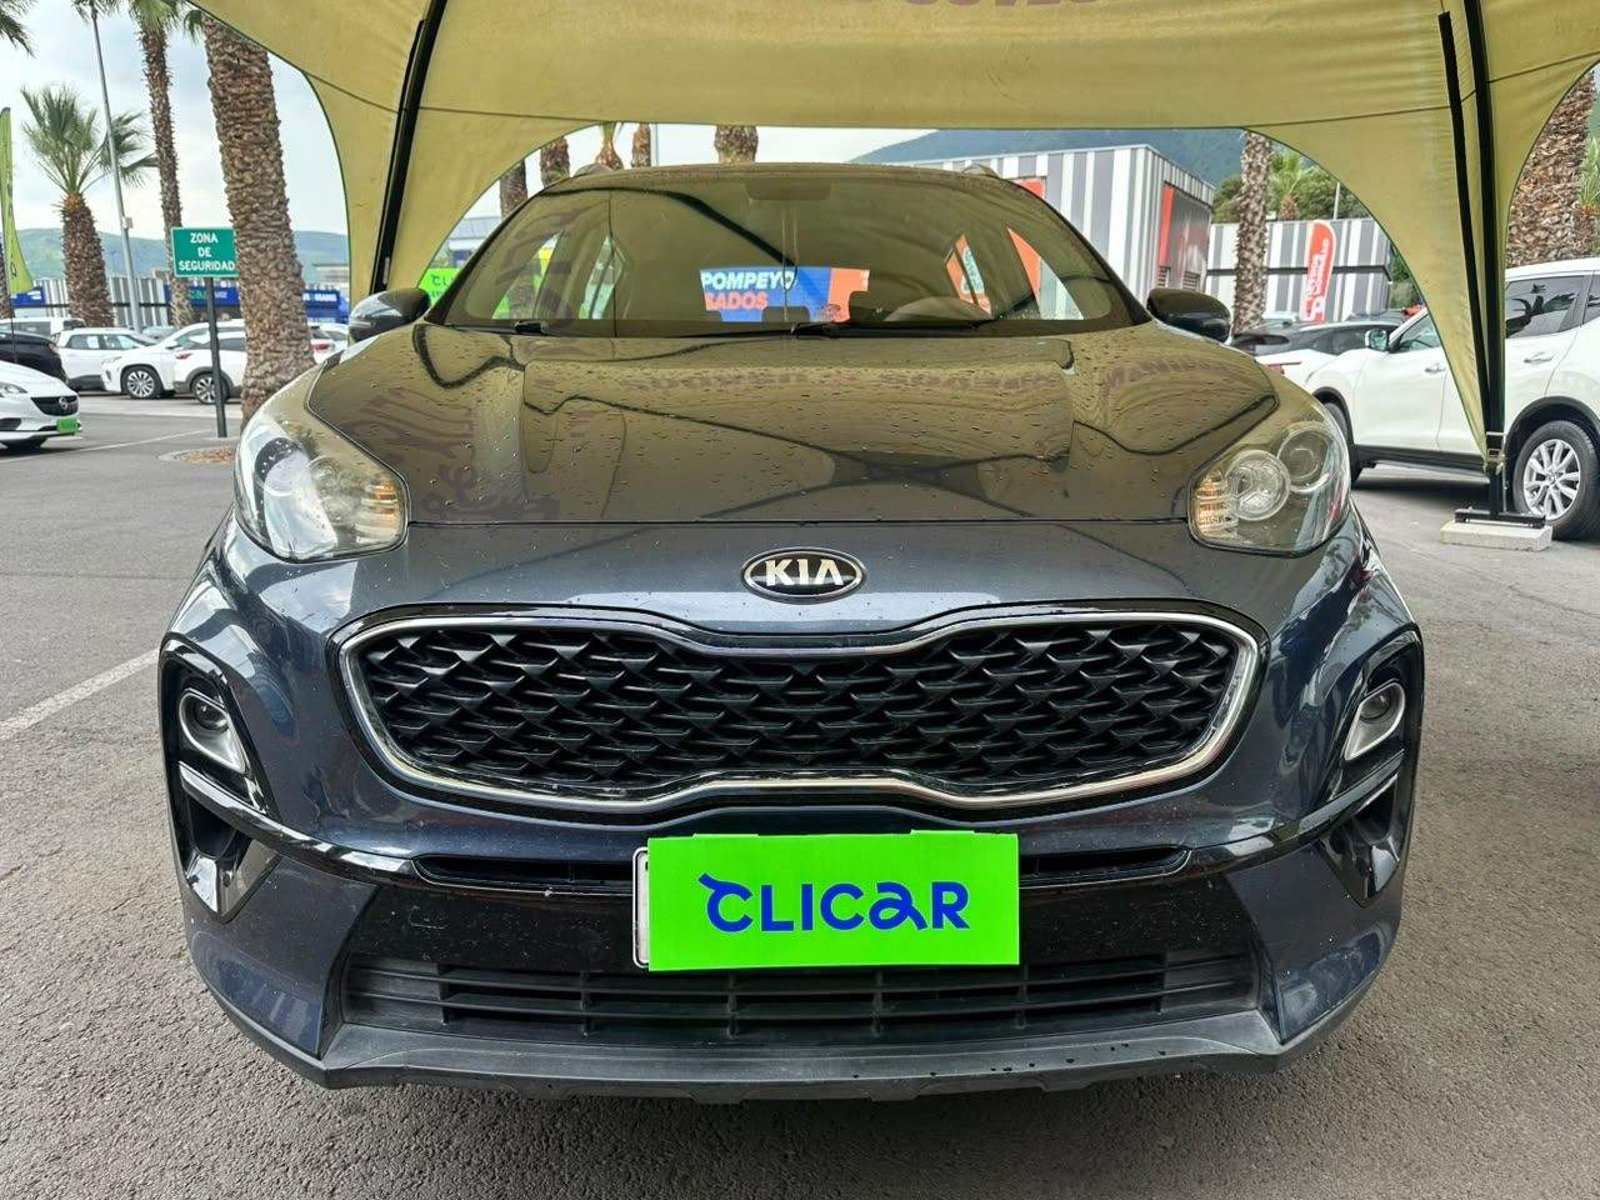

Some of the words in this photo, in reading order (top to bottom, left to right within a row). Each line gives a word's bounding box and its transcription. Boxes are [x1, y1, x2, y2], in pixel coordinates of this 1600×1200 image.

[190, 232, 219, 244] ZONA
[197, 247, 212, 257] DE
[178, 260, 236, 271] SEGURIDAD
[700, 271, 797, 290] POMPEYO
[765, 559, 844, 586] KIA
